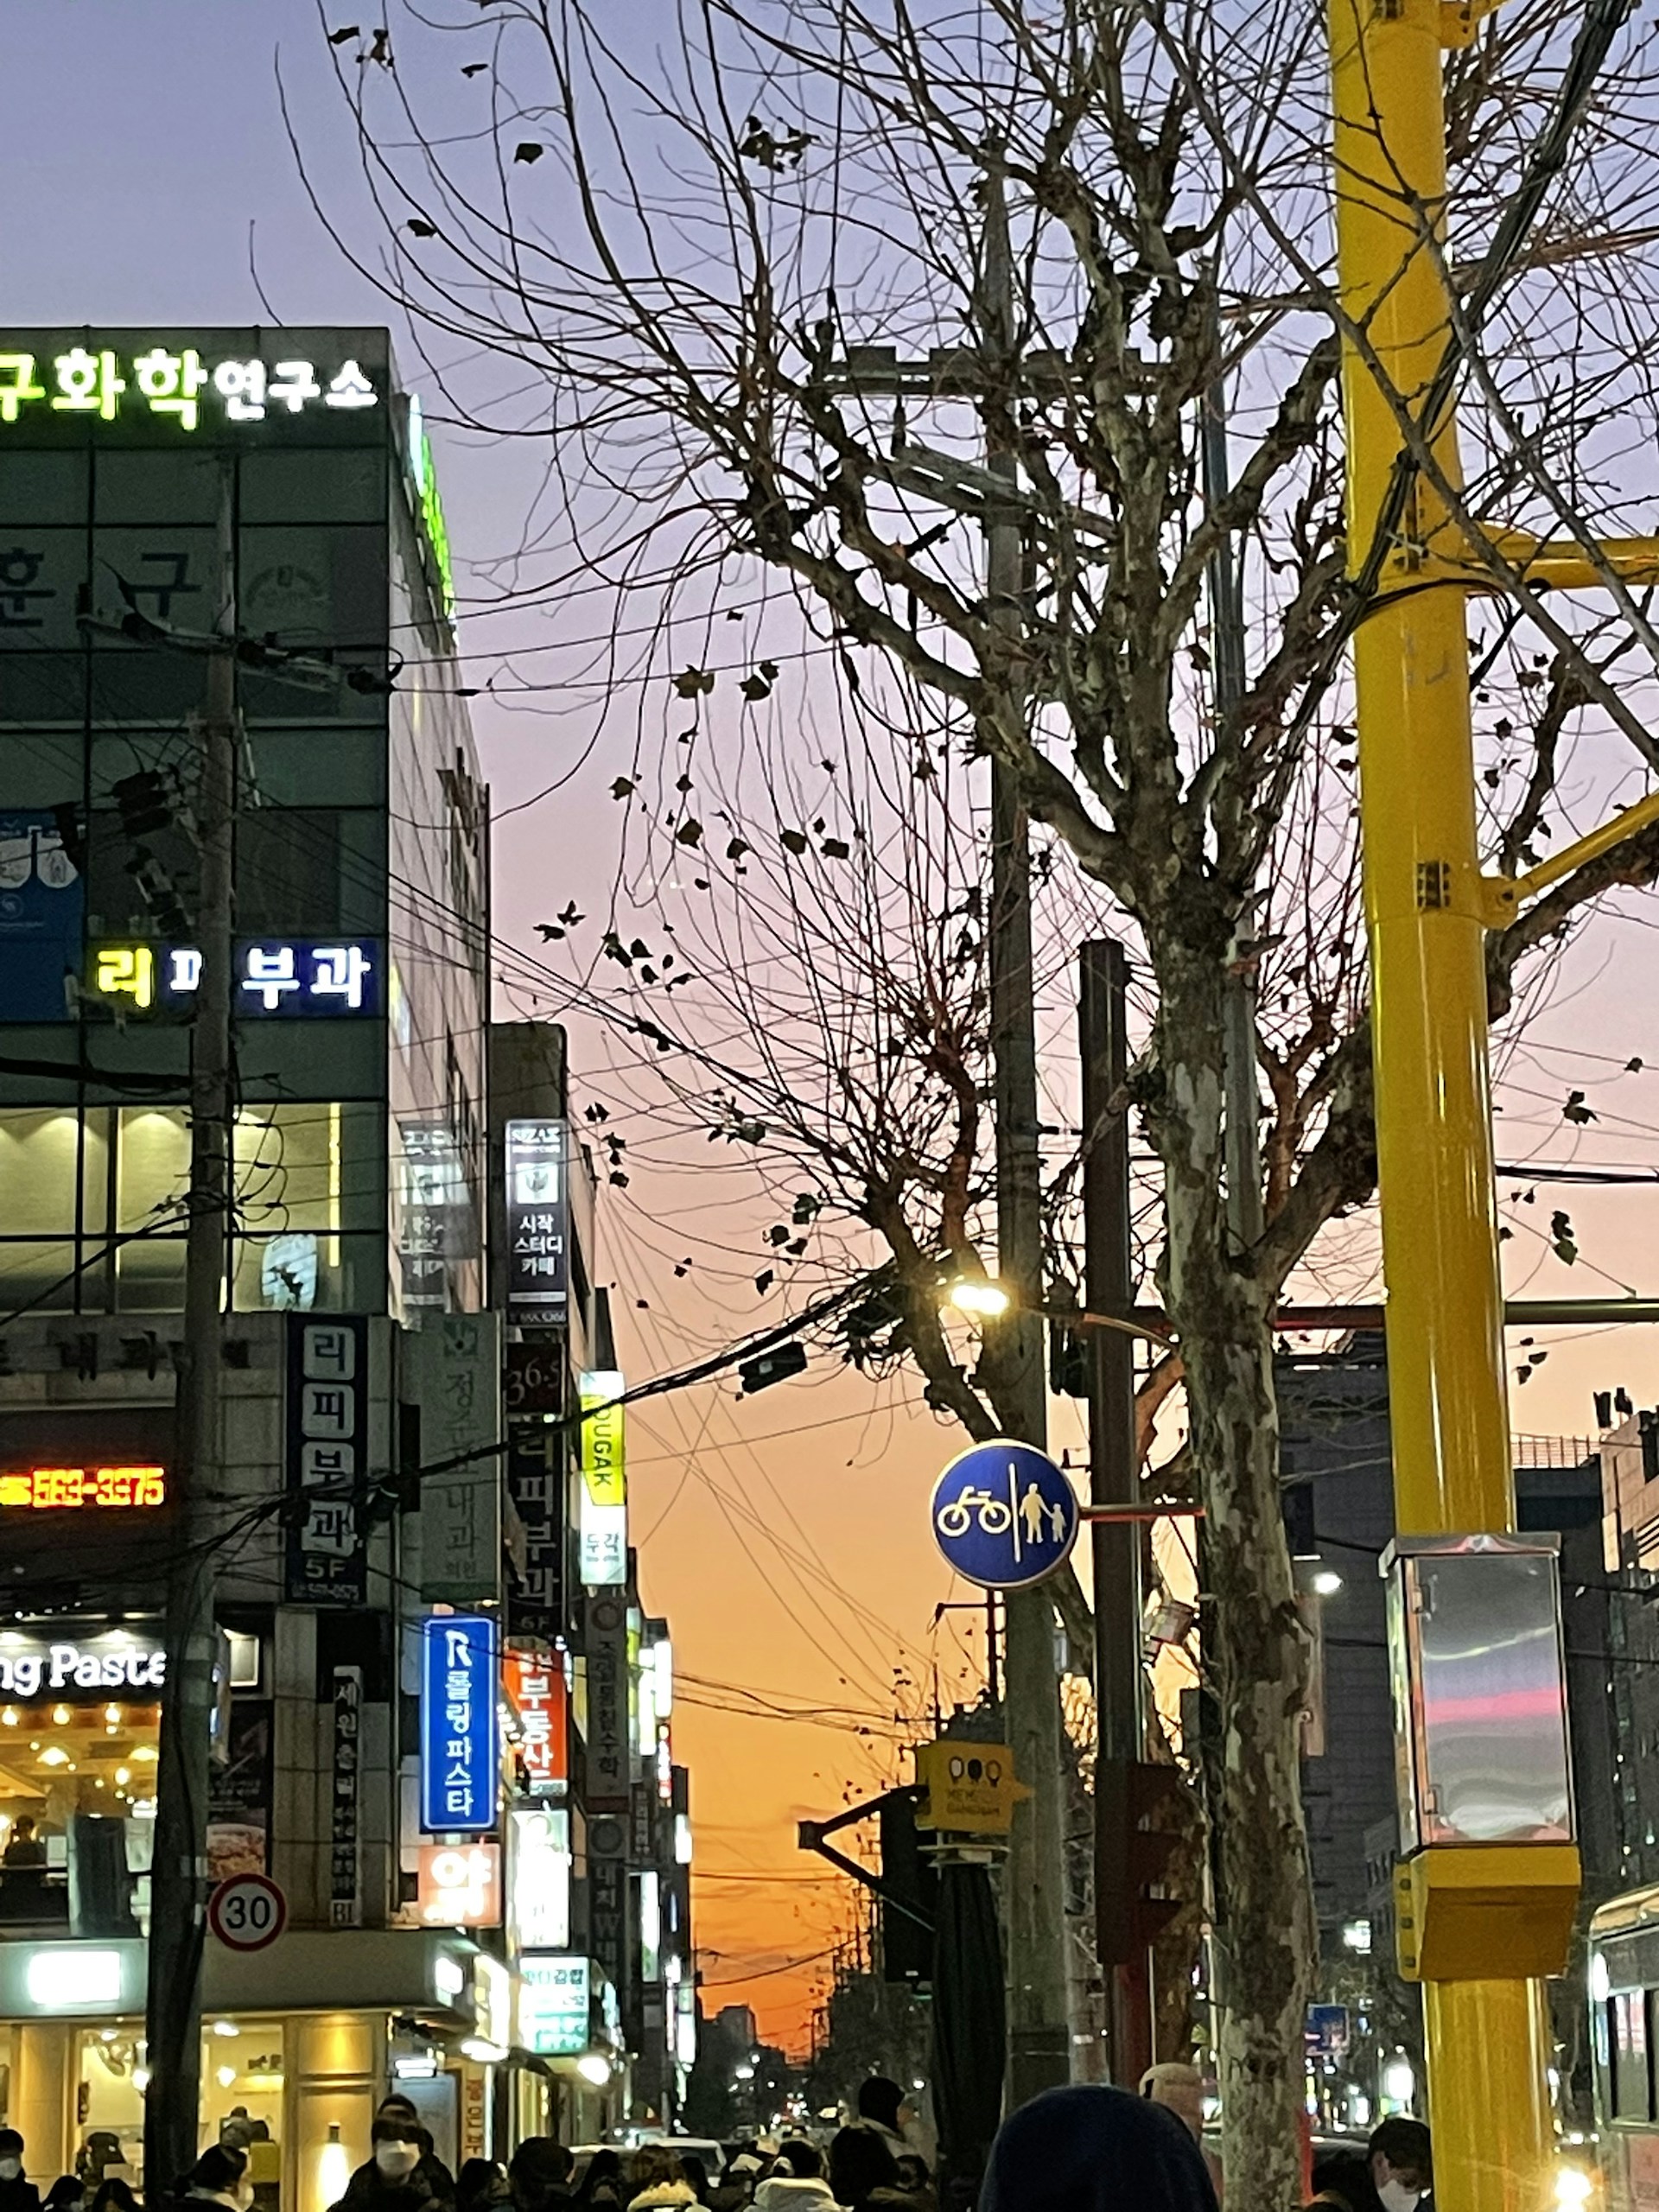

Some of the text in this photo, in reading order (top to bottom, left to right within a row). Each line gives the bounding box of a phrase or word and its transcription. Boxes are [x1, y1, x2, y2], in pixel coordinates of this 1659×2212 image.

[519, 1213, 554, 1233] 시작
[512, 1236, 563, 1255] 스터디
[521, 1257, 556, 1276] 카페
[312, 1333, 348, 1548] 리피부과
[305, 1558, 346, 1579] 5F
[445, 1670, 474, 1818] 롤링파스타
[226, 1896, 270, 1930] 30
